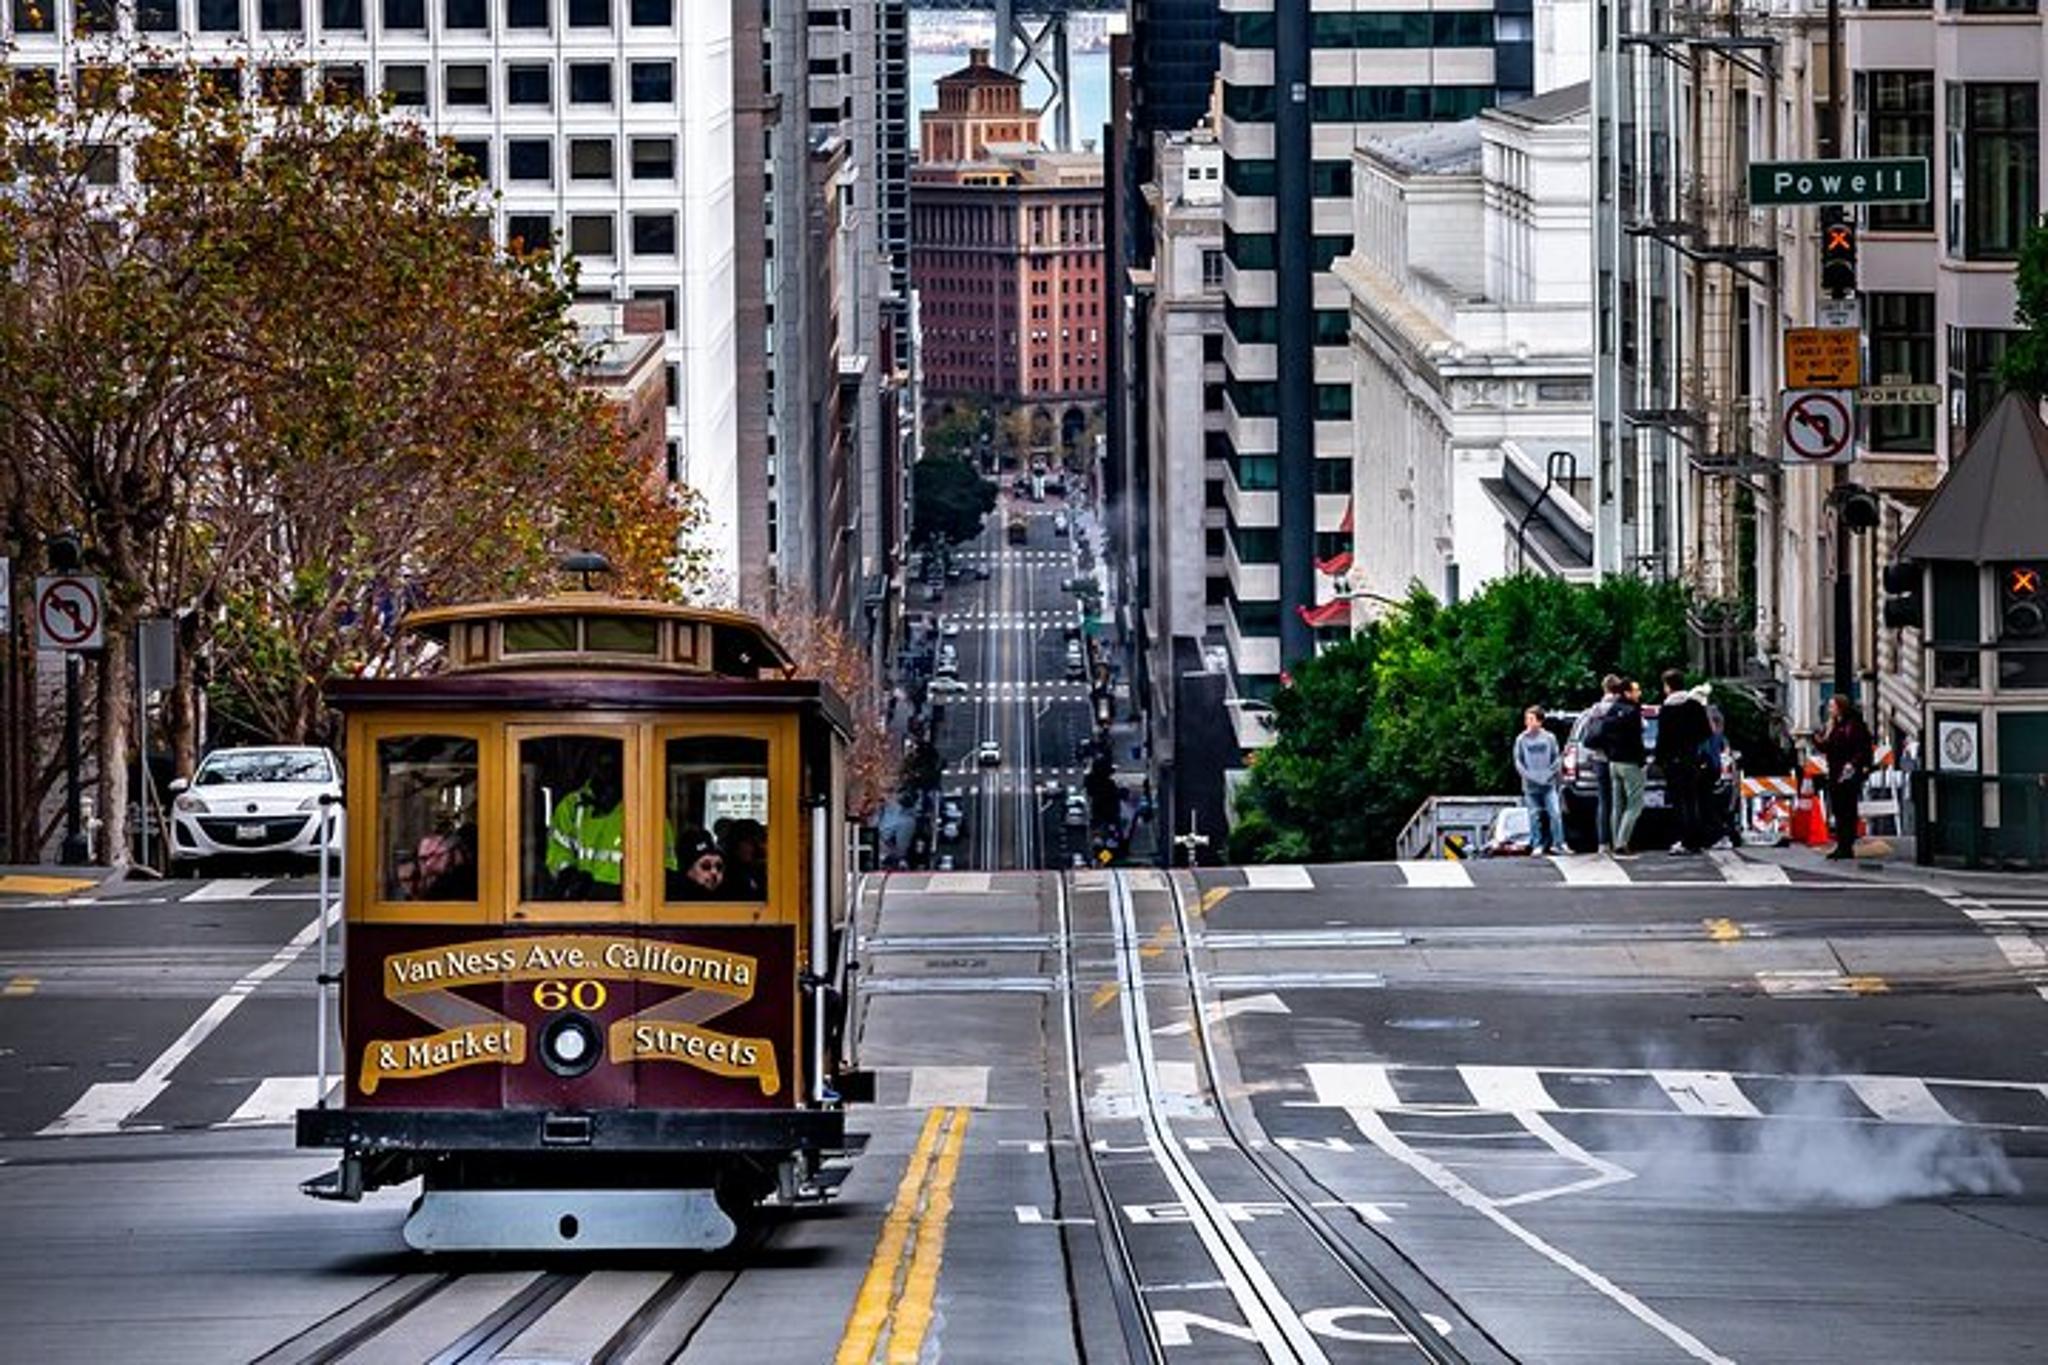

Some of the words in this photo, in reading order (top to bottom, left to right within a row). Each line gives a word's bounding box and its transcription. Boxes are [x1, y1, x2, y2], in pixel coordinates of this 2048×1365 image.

[1774, 169, 1901, 195] Powell
[1860, 388, 1933, 402] POWELL
[394, 958, 442, 983] Van
[445, 949, 516, 978] Ness
[605, 943, 750, 985] California
[533, 981, 607, 1011] 60
[379, 1043, 399, 1069] &
[407, 1029, 513, 1069] Market
[635, 1026, 757, 1065] Streets
[1014, 1202, 1410, 1224] LEFT
[1151, 1306, 1454, 1346] NO
